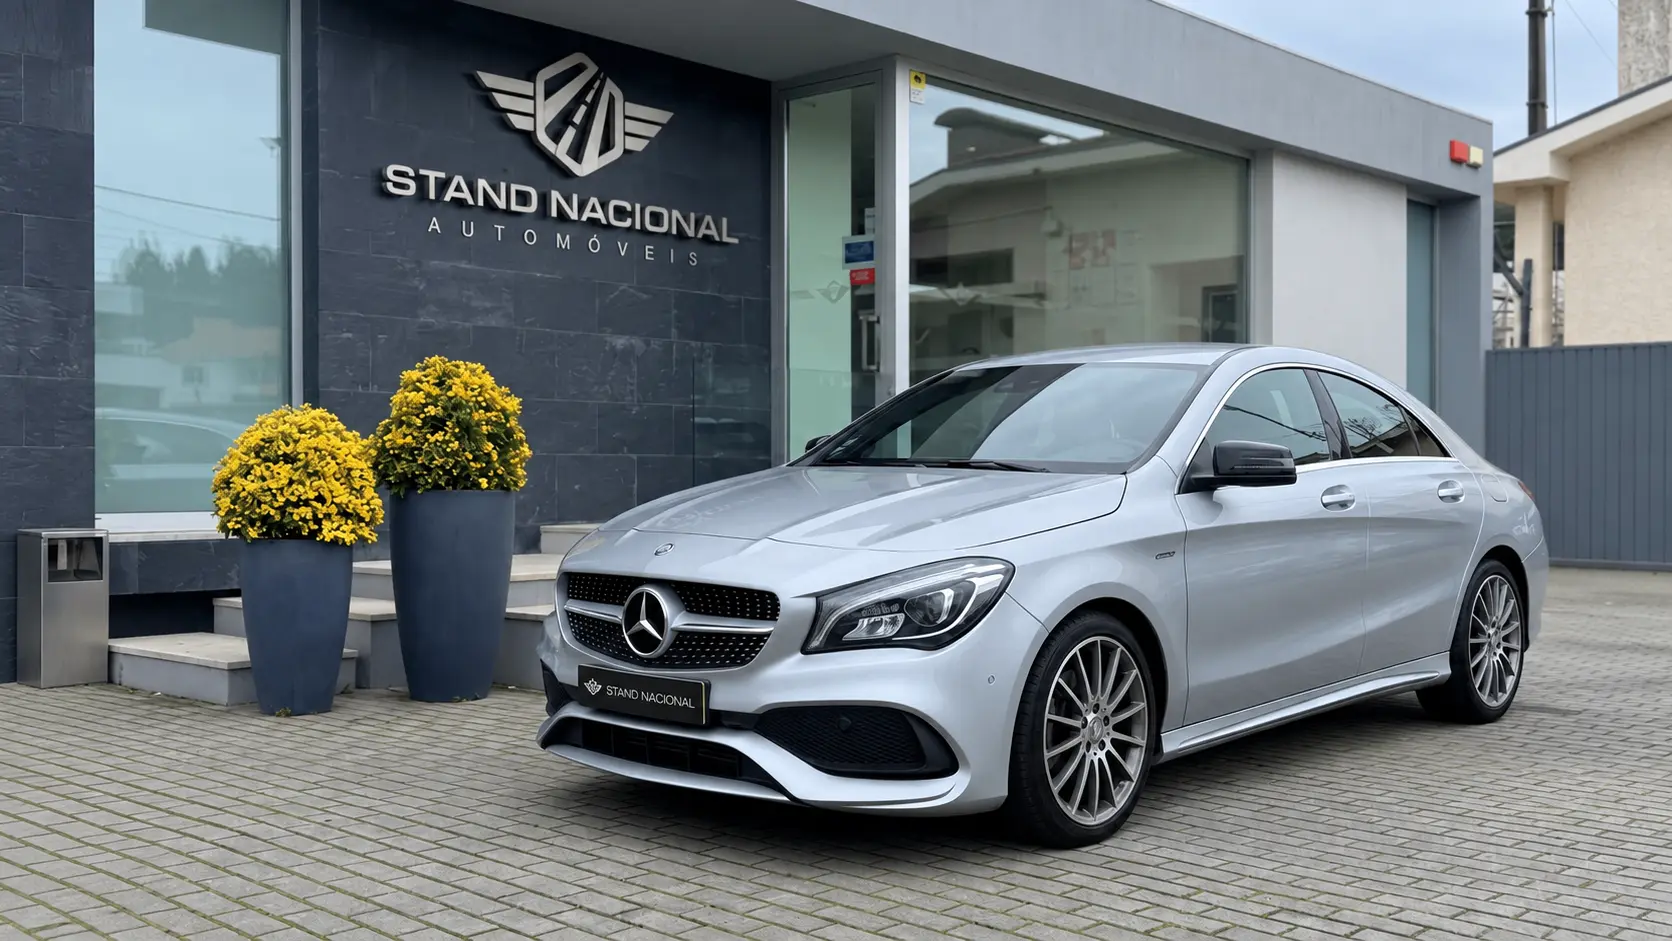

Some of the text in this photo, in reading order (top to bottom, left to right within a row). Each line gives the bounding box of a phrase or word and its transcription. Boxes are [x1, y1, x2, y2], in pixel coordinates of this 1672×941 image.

[385, 164, 739, 244] STAND NACIONAL
[606, 685, 695, 708] STAND NACIONAL
